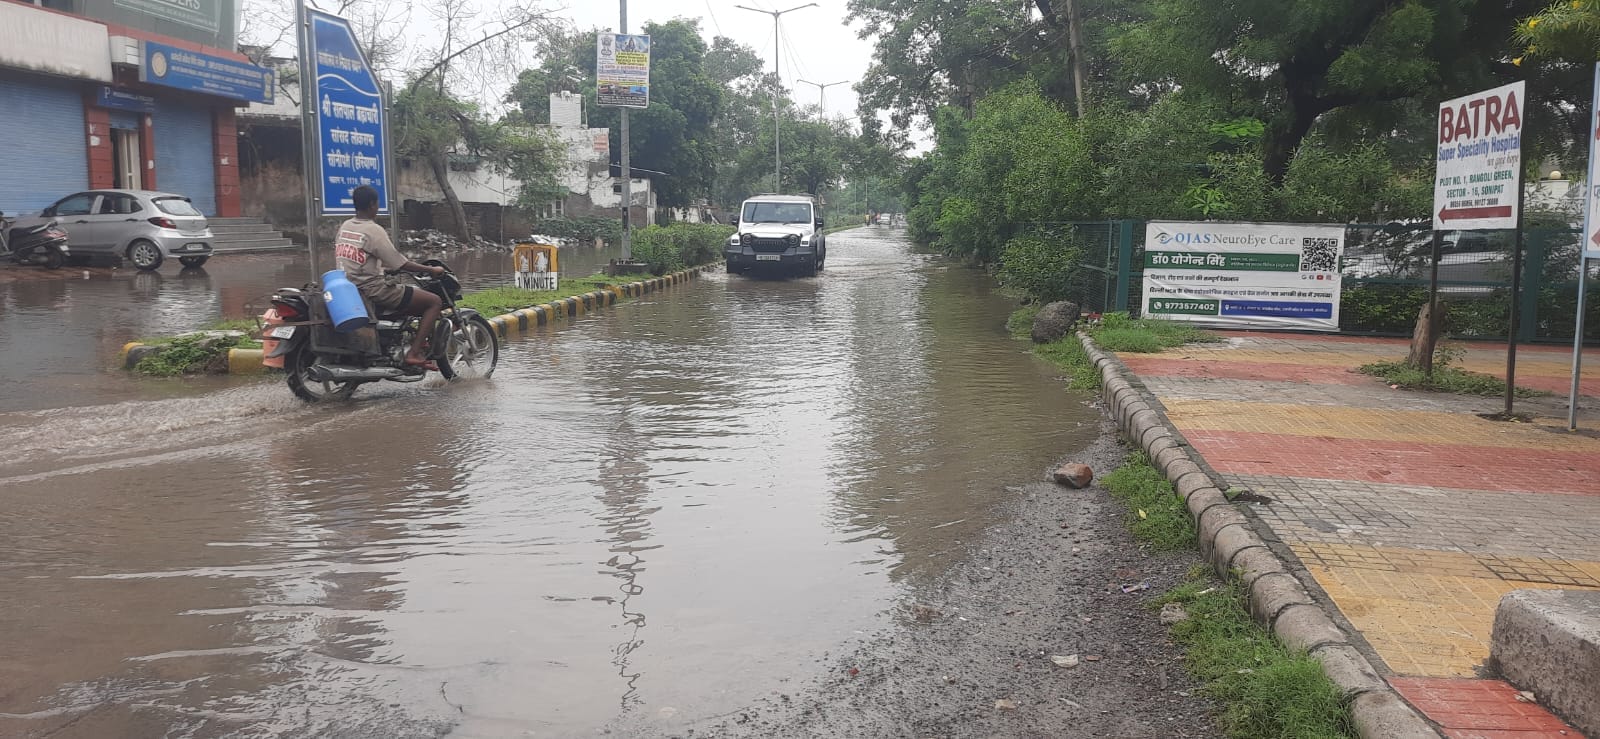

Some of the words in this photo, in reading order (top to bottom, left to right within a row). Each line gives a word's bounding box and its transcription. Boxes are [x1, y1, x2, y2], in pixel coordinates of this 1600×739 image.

[322, 93, 331, 118] श्री
[332, 101, 355, 121] सतपाल
[1440, 91, 1521, 145] BATRA
[330, 126, 349, 144] सांसद
[350, 127, 375, 147] लोकसभा
[1439, 146, 1456, 164] Super
[1457, 138, 1490, 161] Speciality
[1491, 132, 1520, 155] Hospital
[1440, 177, 1452, 187] PLOT
[1453, 176, 1461, 185] NO.
[1469, 172, 1493, 183] RANGOLI
[1494, 170, 1513, 181] GREEN,
[1446, 188, 1466, 198] SECTOR
[1481, 184, 1504, 195] SONIPAT
[1175, 232, 1211, 244] OJAS
[1213, 233, 1267, 247] NeuroEye
[1269, 234, 1296, 245] Care
[1171, 253, 1204, 265] योगेन्द्र
[1206, 253, 1226, 266] सिंह
[523, 276, 555, 289] MINUTE
